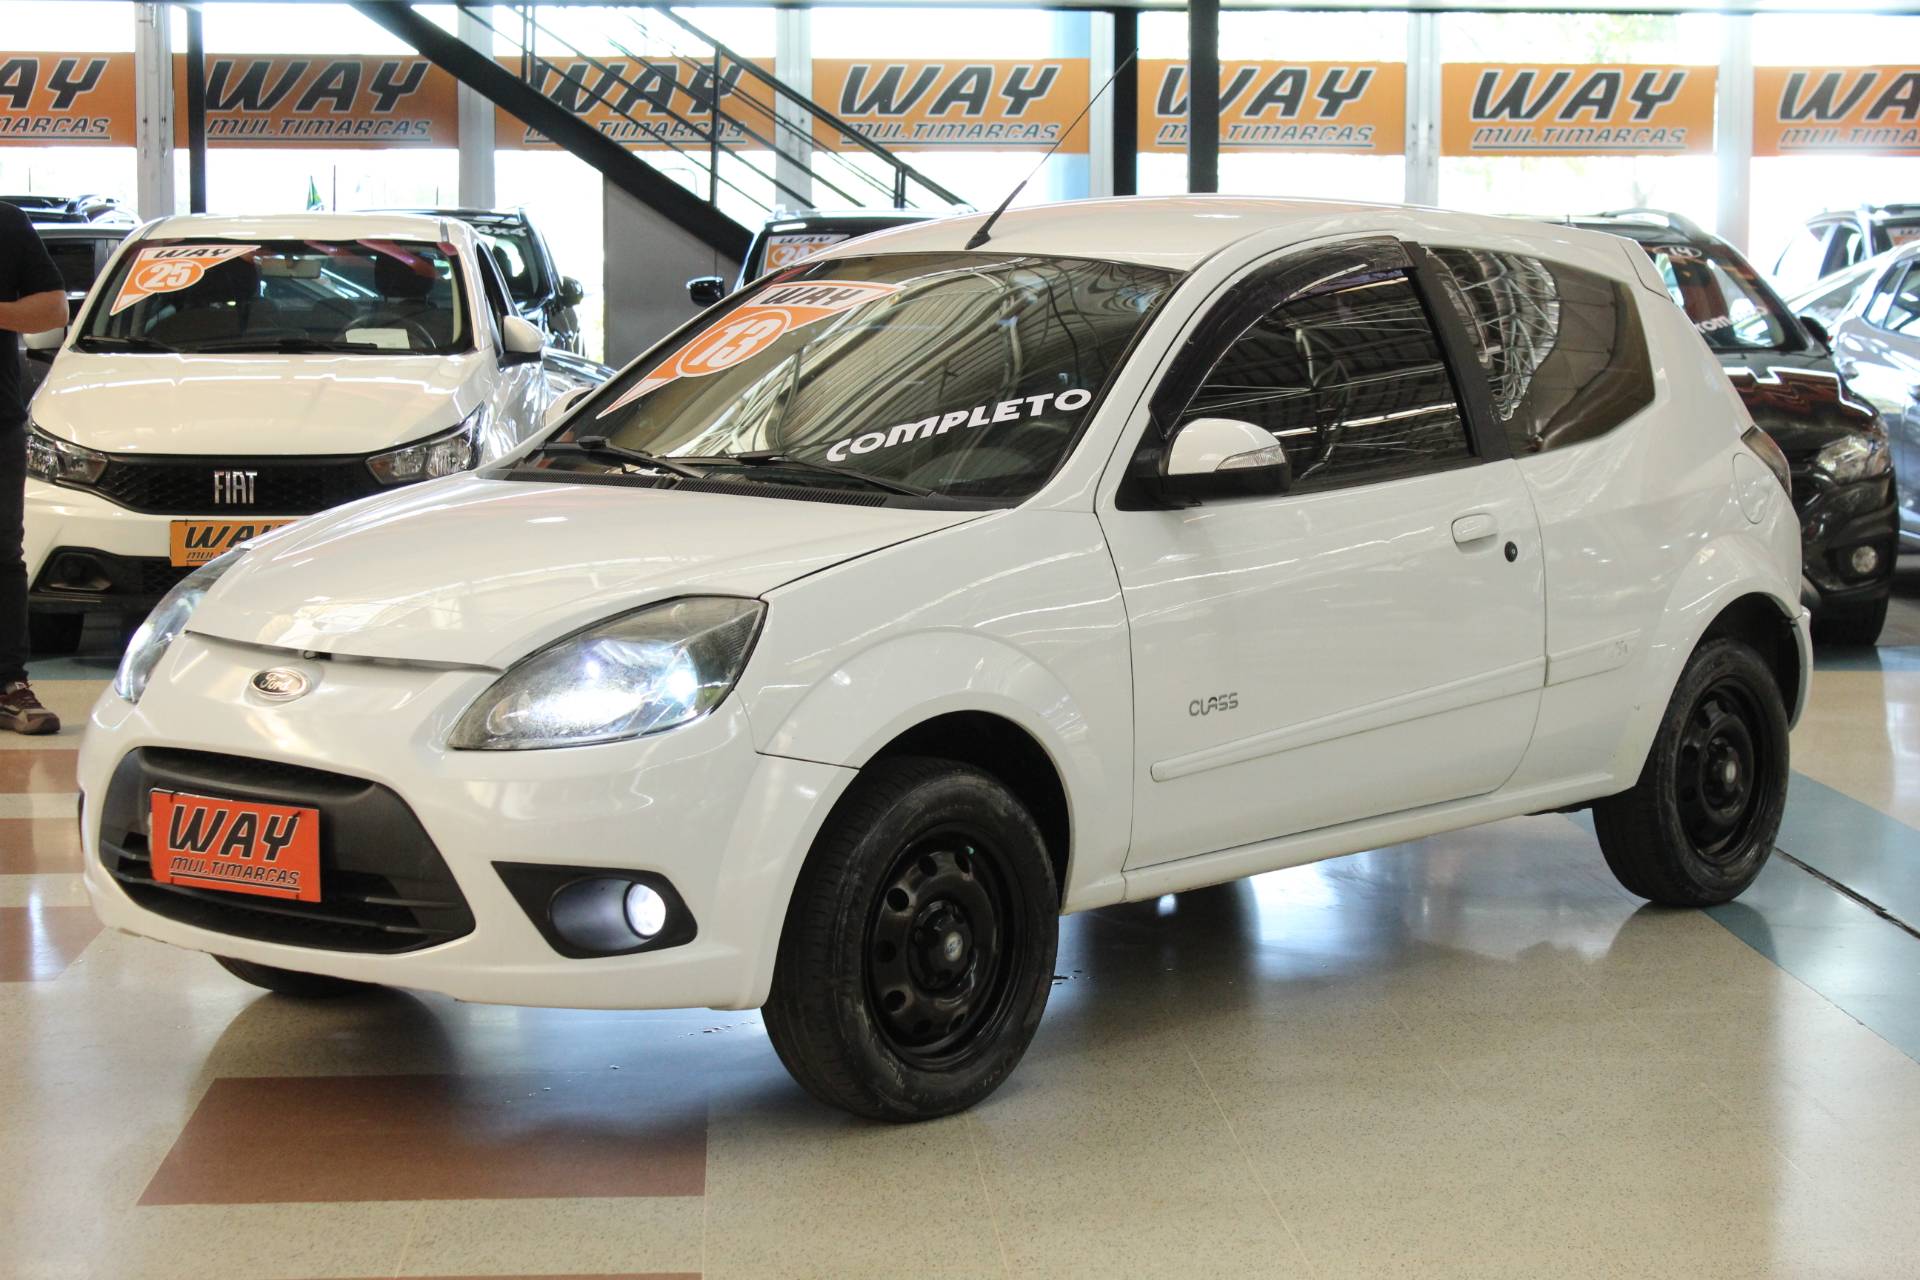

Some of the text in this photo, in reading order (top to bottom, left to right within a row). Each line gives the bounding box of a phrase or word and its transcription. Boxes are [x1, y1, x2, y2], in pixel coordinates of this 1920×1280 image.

[0, 57, 110, 111] AY
[205, 60, 431, 113] WAY
[840, 64, 1061, 117] WAY
[1155, 66, 1375, 119] WAY
[1470, 69, 1689, 122] WAY
[1777, 71, 1920, 122] WA
[207, 119, 431, 136] MULTIMARCAS
[843, 123, 1060, 139] MULTIMARCAS
[1157, 124, 1373, 141] MTIMARCAS
[1473, 128, 1686, 144] MULTIMARCAS
[153, 248, 231, 258] WAY
[143, 262, 195, 289] 25
[759, 286, 866, 306] WAY
[687, 318, 783, 368] 13
[826, 388, 1092, 462] COMPLETO
[214, 471, 258, 504] FIAT
[1189, 692, 1239, 717] CLASS
[168, 804, 301, 862] WAY
[170, 857, 300, 886] MULTIMARCAS
